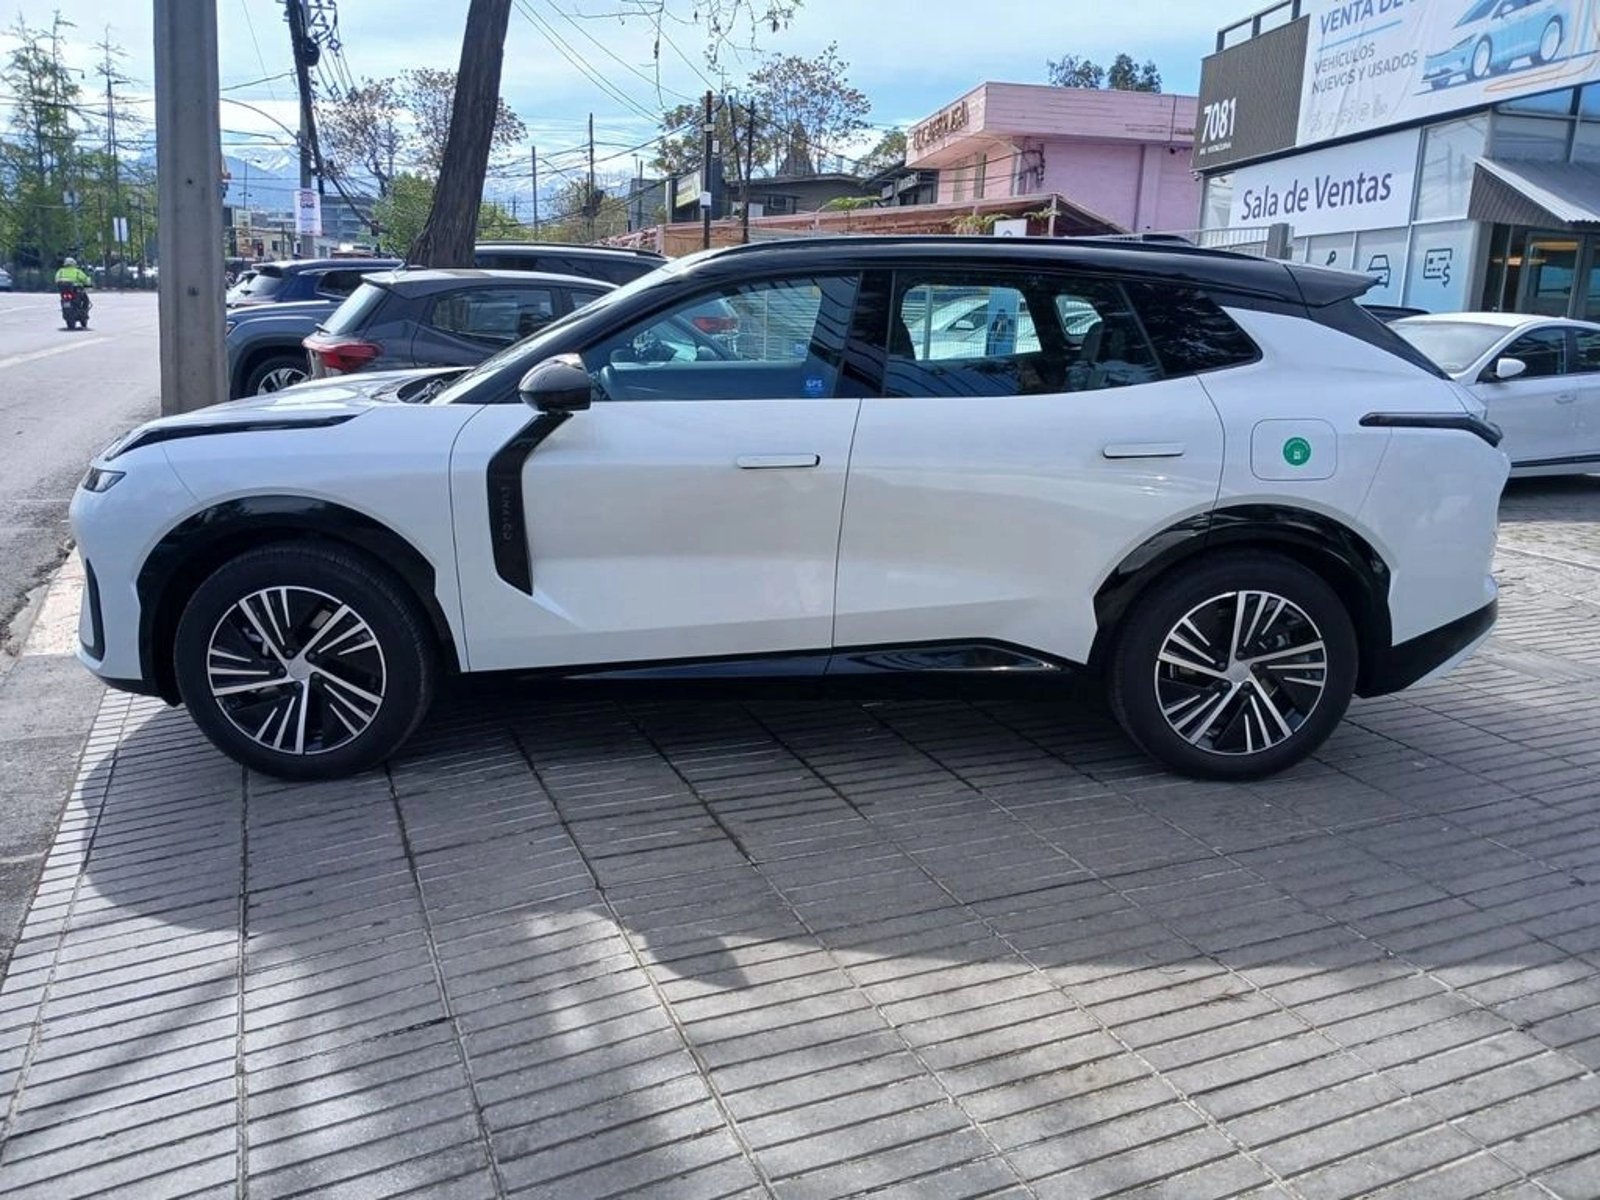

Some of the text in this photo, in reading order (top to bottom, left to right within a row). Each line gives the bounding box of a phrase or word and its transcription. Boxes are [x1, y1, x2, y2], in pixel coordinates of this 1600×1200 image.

[1321, 0, 1374, 35] VENTA
[1358, 66, 1366, 81] Y
[1367, 50, 1418, 78] USADOS
[1201, 97, 1236, 144] 7081
[1241, 171, 1393, 221] Sala de Ventas
